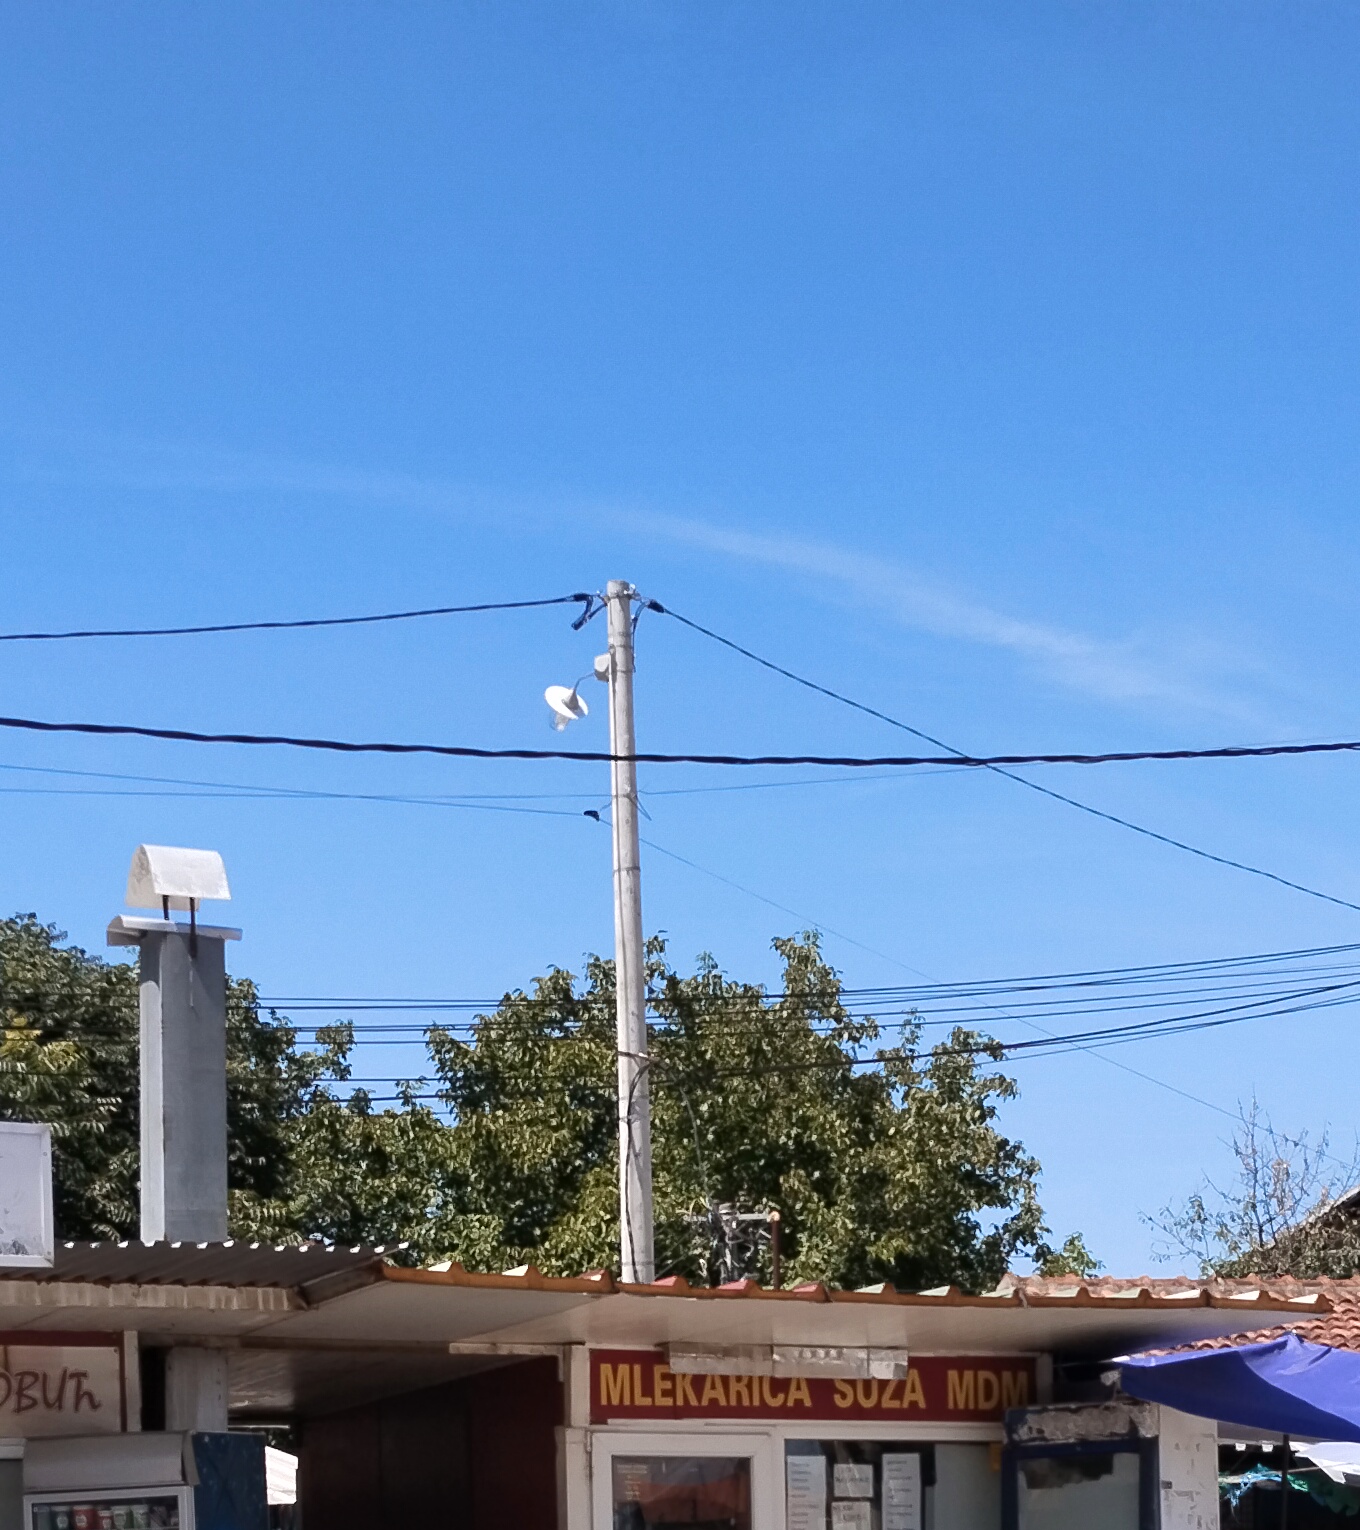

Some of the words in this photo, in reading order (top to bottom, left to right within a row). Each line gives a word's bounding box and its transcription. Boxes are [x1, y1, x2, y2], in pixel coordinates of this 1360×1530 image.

[598, 1363, 813, 1408] MLEKARICA
[833, 1369, 928, 1410] SUZA
[947, 1369, 1029, 1412] MDM
